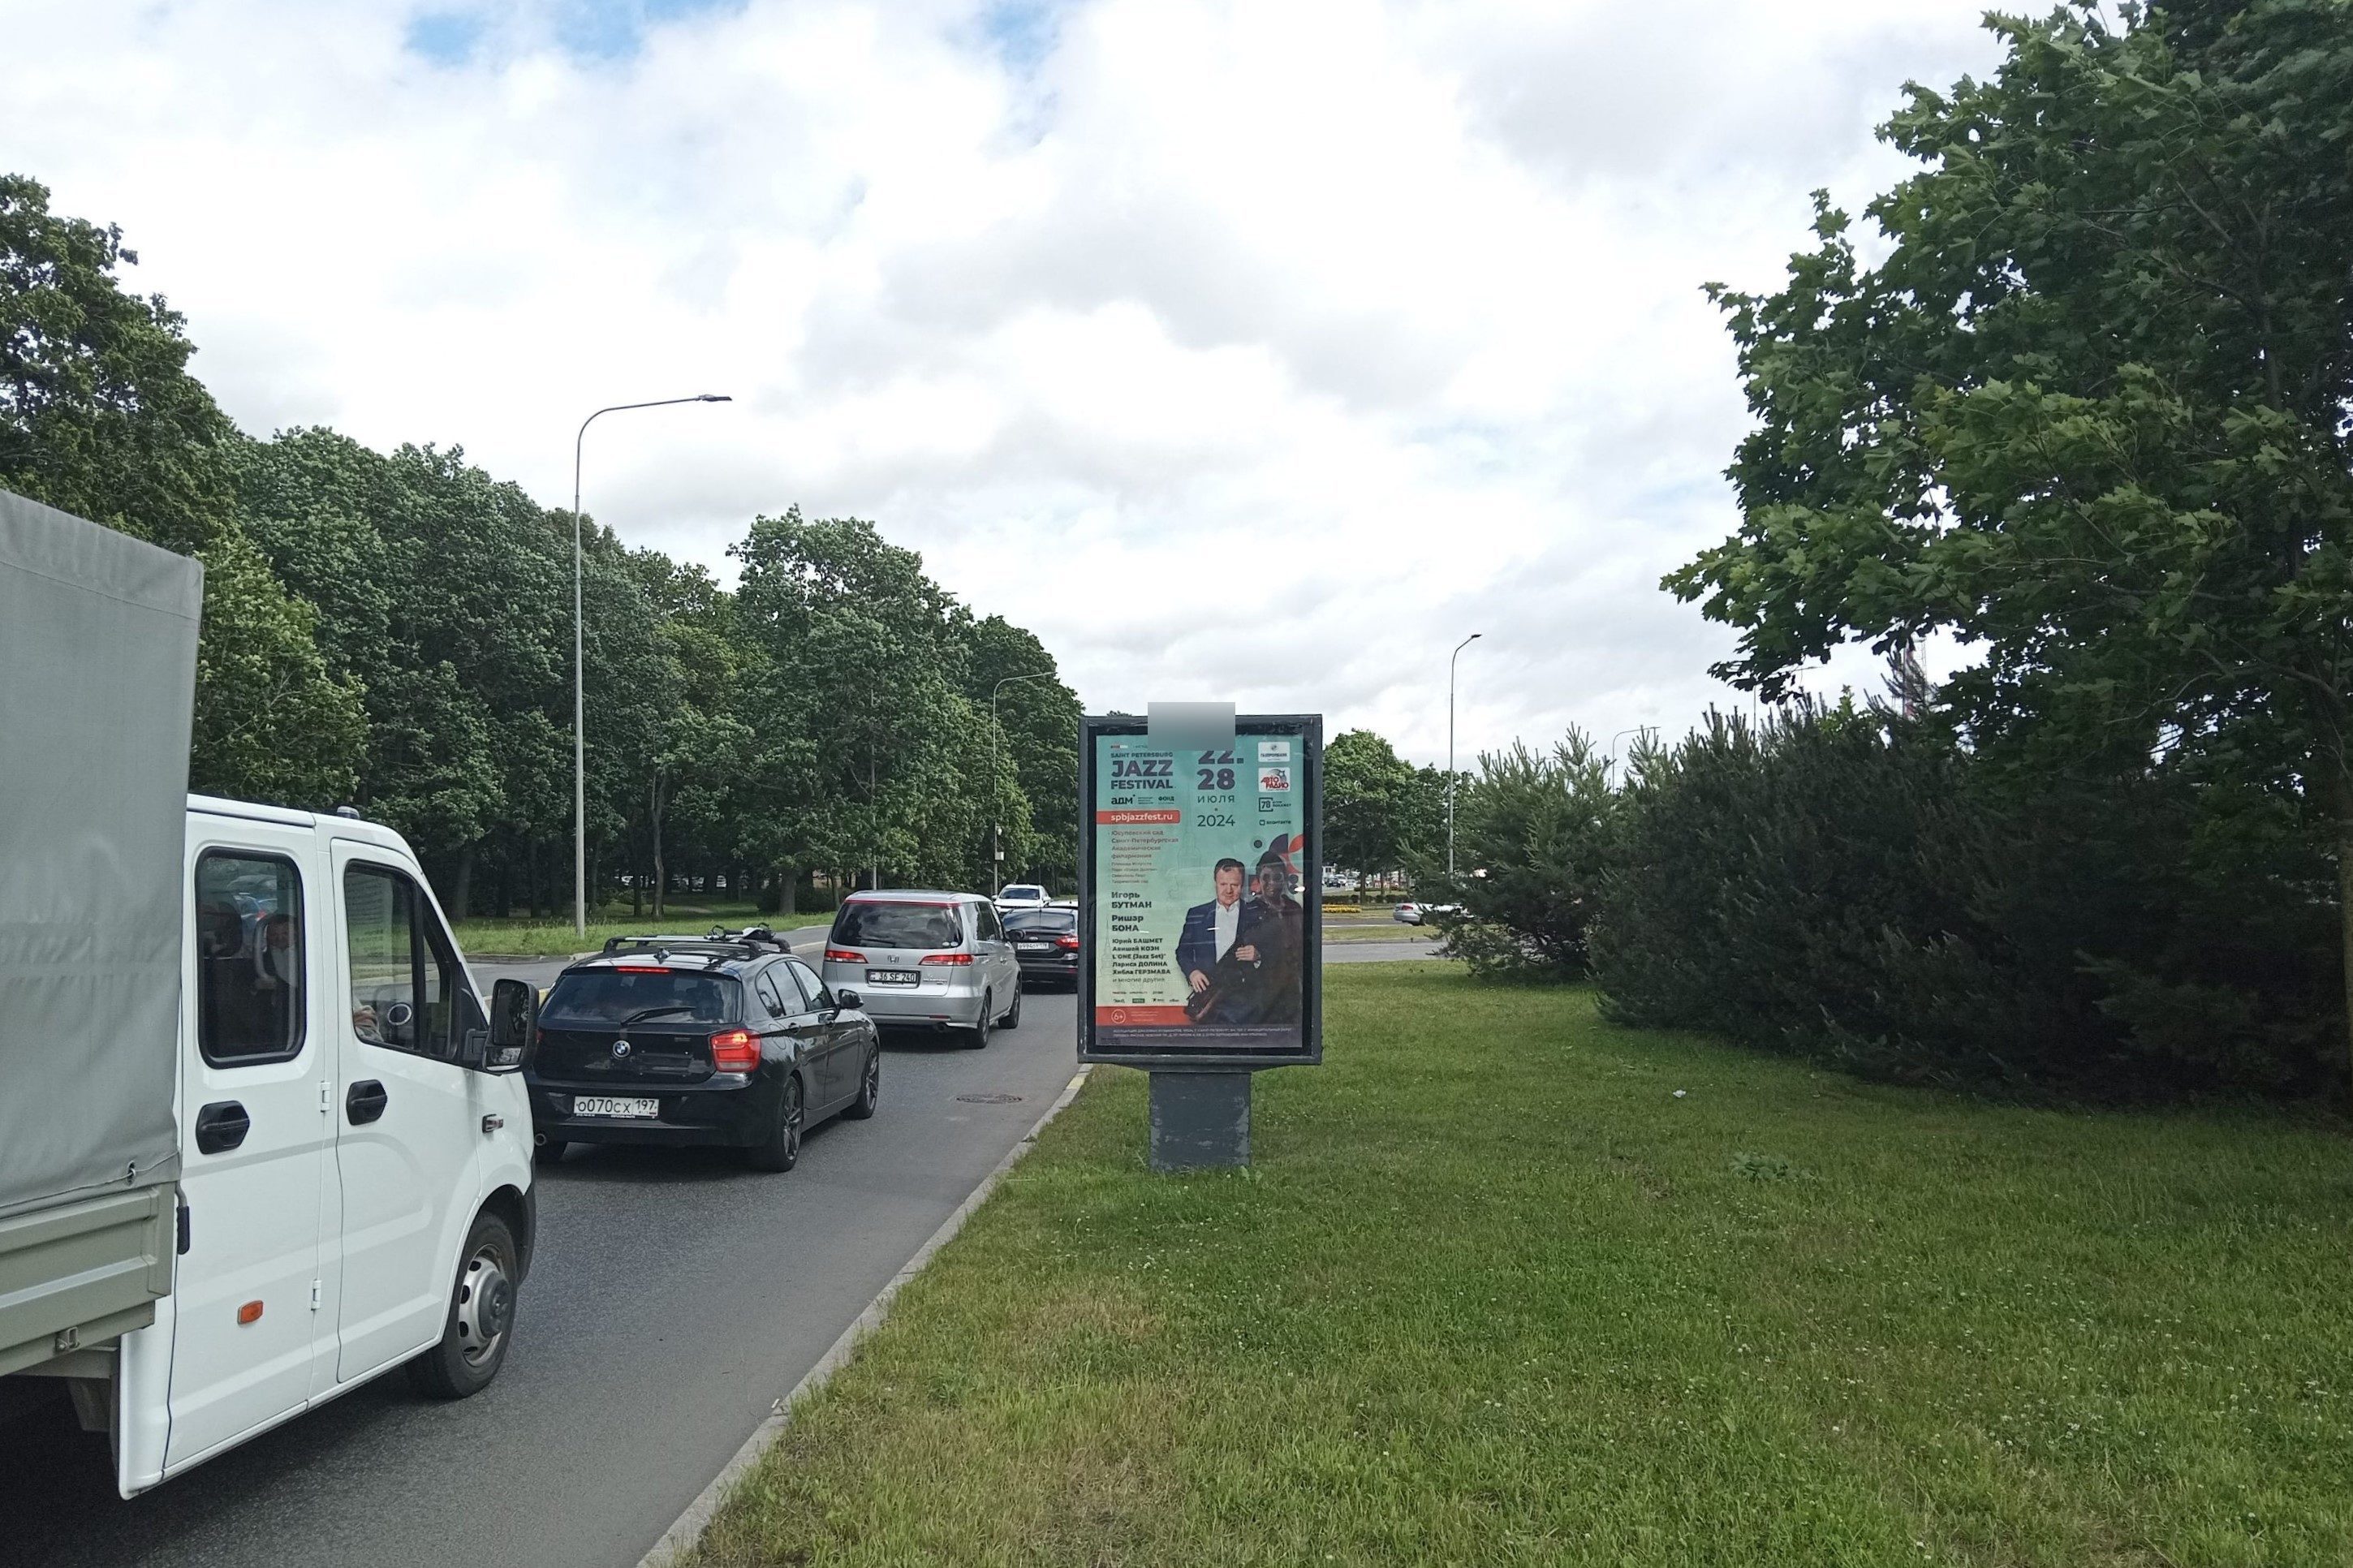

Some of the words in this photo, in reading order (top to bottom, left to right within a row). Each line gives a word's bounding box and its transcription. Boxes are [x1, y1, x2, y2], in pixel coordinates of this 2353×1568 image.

[1110, 760, 1174, 777] JAZZ
[1196, 768, 1235, 790] 28
[1110, 779, 1174, 790] FESTIVAL
[1261, 800, 1271, 809] 78
[1110, 812, 1174, 823] spbjazzfest.ru
[1196, 814, 1236, 827] 2024
[1111, 891, 1140, 900] Игорь
[1111, 901, 1152, 909] БУТМАН
[1112, 915, 1144, 924] Ришар
[902, 973, 916, 981] 240
[1114, 1012, 1124, 1020] 6+
[635, 1100, 656, 1111] 197
